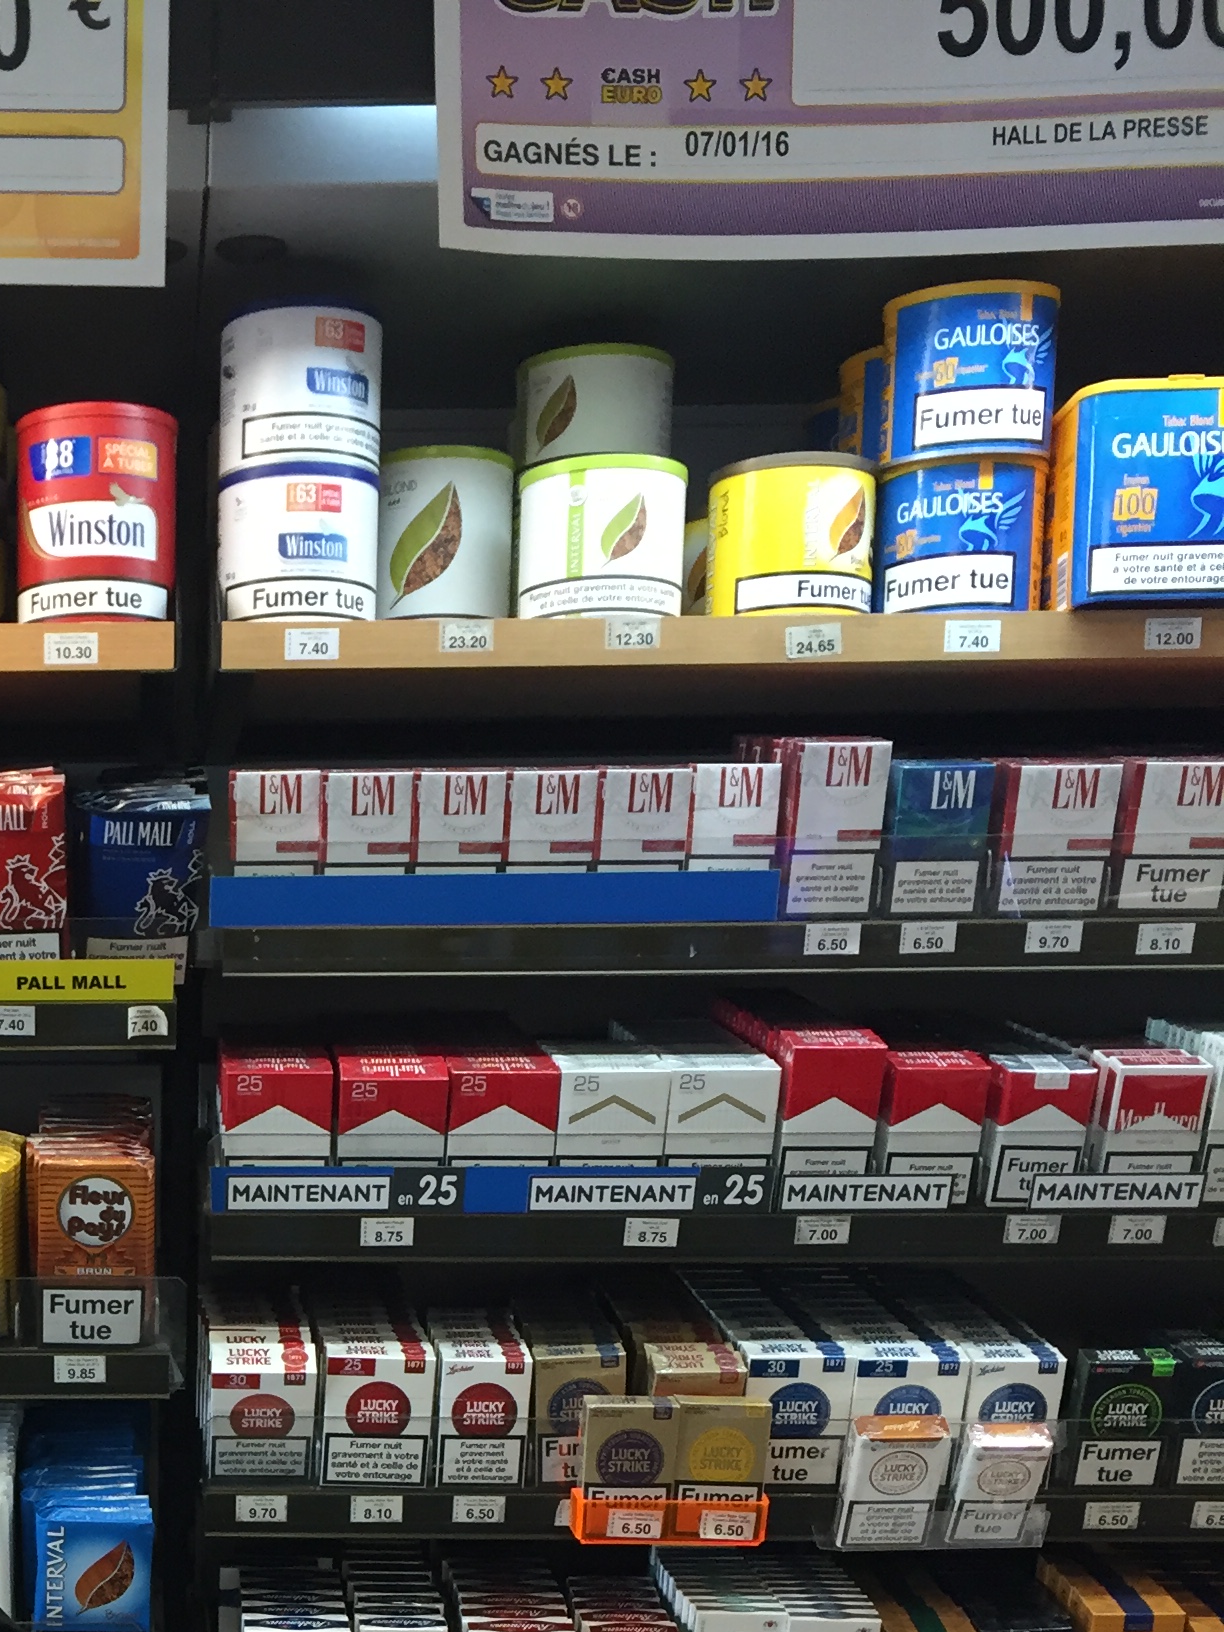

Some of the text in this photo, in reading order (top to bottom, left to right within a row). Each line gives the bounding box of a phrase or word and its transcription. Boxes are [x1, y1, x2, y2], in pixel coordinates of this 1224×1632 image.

[937, 0, 1224, 71] 500,0
[600, 84, 663, 105] EURO
[483, 115, 1209, 168] GAGNÉS LE 07/01/16 HALL DE LA PRESSE
[935, 323, 1039, 350] GAULOISES
[920, 404, 1042, 430] Fumer tue
[897, 492, 1003, 523] GAULOISES
[48, 509, 145, 547] Winston
[286, 536, 344, 560] Winston
[886, 568, 1009, 602] Fumer tue
[31, 586, 143, 614] Fumer tue
[253, 588, 364, 612] Fumer tue
[449, 634, 487, 649] 23.20
[796, 638, 835, 654] 24.65
[958, 635, 989, 649] 7.40
[1155, 632, 1194, 646] 12.00
[55, 646, 93, 660] 10.30
[259, 773, 303, 815] L&M
[930, 769, 976, 811] L&M
[1136, 862, 1210, 886] Fumer
[1151, 885, 1187, 904] tue
[817, 938, 848, 952] 6.50
[1038, 935, 1070, 949] 9.70
[1150, 937, 1181, 951] 8.10
[16, 975, 127, 990] PALL MALL
[237, 1075, 263, 1093] 25
[574, 1075, 600, 1093] 25
[69, 1184, 127, 1207] Fleur
[232, 1174, 458, 1206] MAINTENANT en 25
[535, 1184, 693, 1205] MAINTENANT
[788, 1183, 948, 1203] MAINTENANT
[67, 1216, 126, 1242] Pays
[375, 1230, 404, 1244] 8.75
[808, 1228, 838, 1242] 7.00
[50, 1293, 134, 1316] Fumer
[70, 1320, 113, 1341] tue
[360, 1399, 400, 1412] LUCKY
[1108, 1402, 1149, 1415] LUCKY
[357, 1411, 399, 1426] STRIKE
[1103, 1414, 1147, 1429] STRIKE
[1083, 1444, 1156, 1462] Fumer
[1098, 1466, 1132, 1483] tue
[248, 1506, 277, 1520] 9.70
[364, 1506, 392, 1520] 8.10
[47, 1525, 67, 1627] INTERVAL
